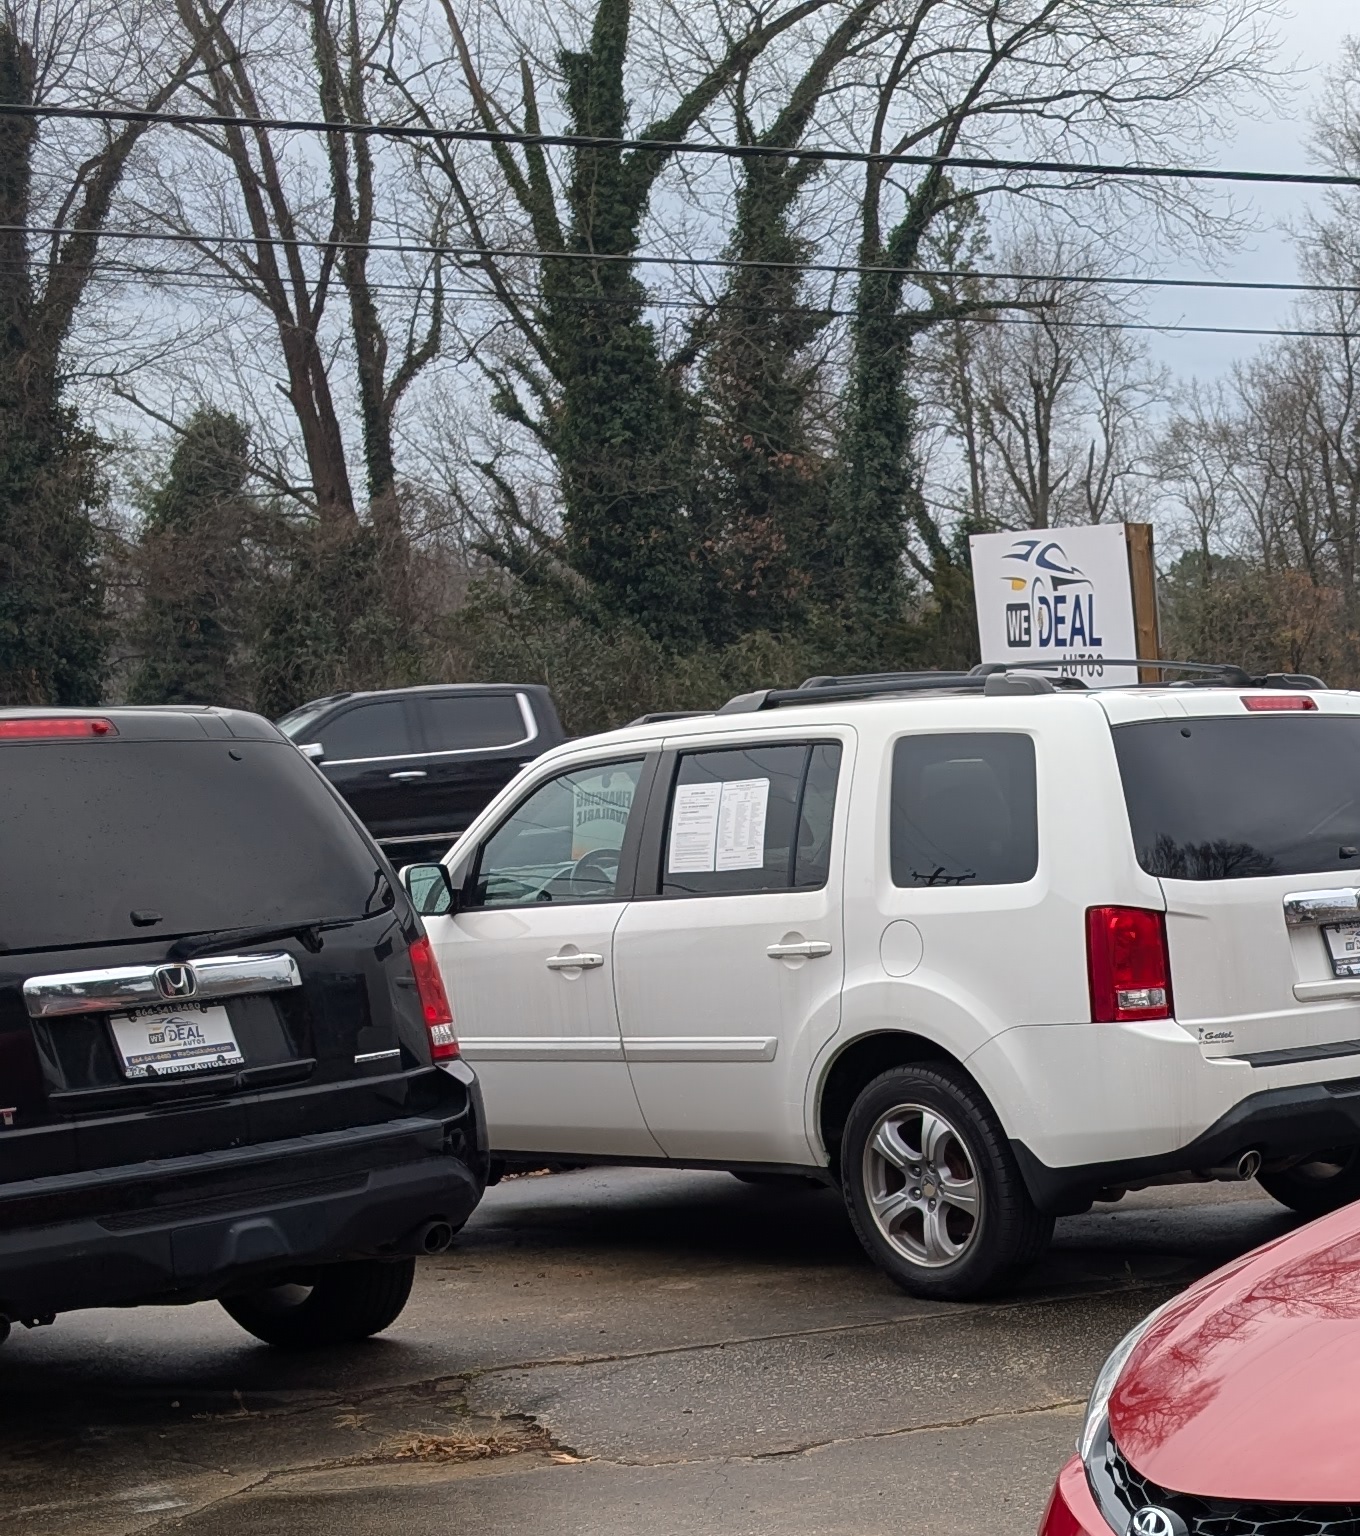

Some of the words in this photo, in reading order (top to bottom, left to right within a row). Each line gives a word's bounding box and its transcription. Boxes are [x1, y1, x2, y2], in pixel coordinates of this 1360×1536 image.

[1008, 609, 1030, 642] WE
[1038, 593, 1103, 648] DEAL
[1060, 653, 1104, 678] AUTOS
[149, 1033, 164, 1043] WE
[168, 1025, 205, 1041] DEAL
[182, 1038, 206, 1047] AUTOS
